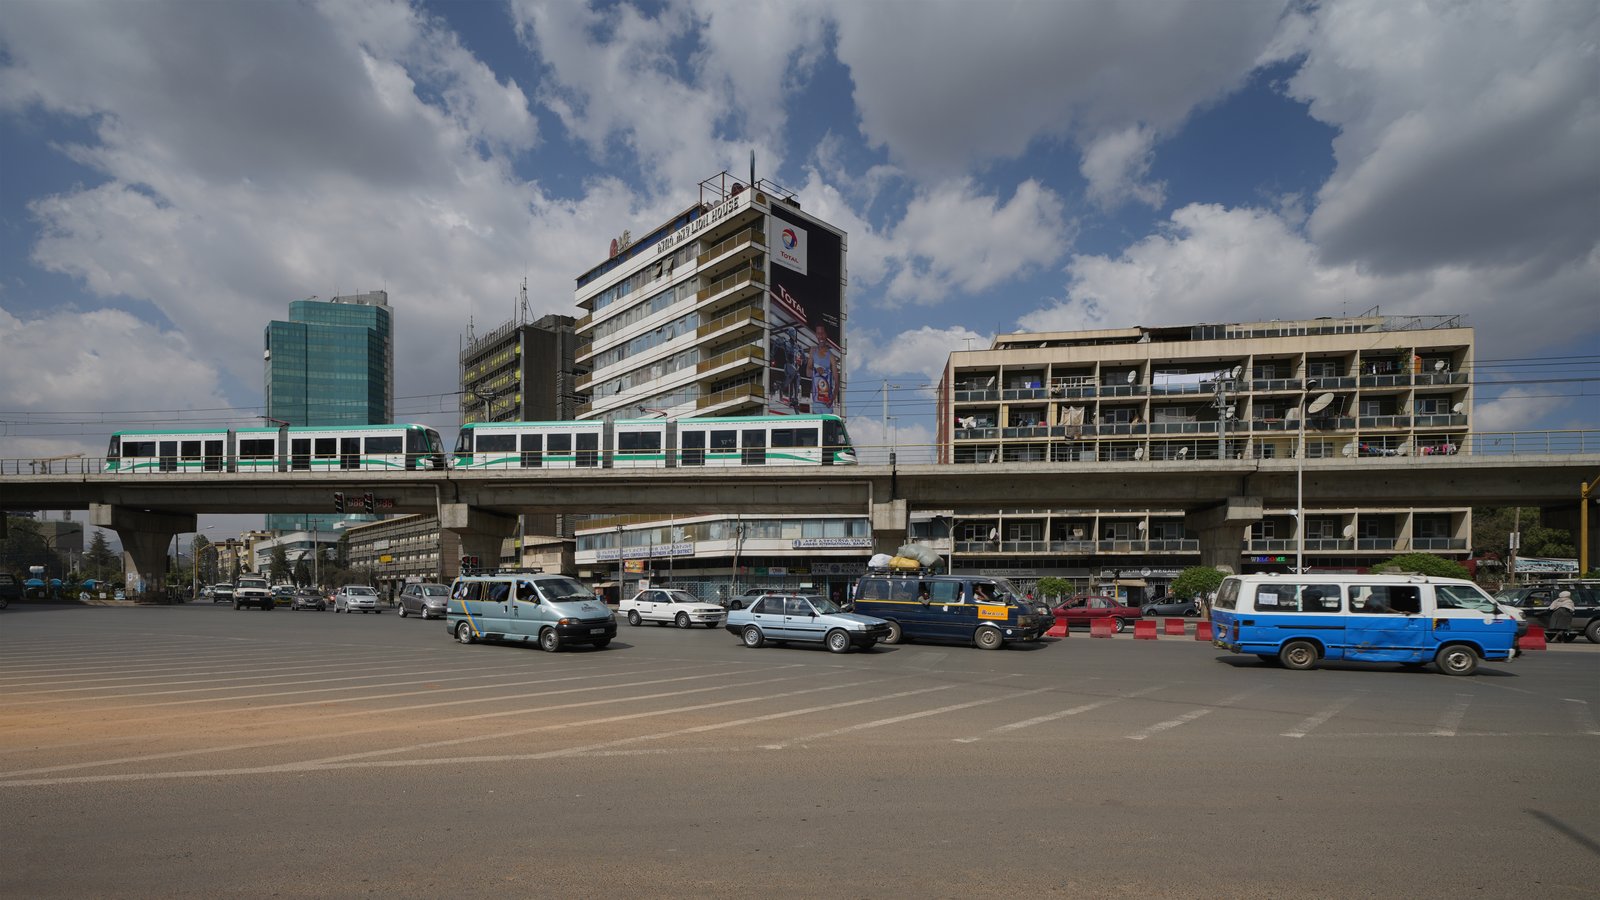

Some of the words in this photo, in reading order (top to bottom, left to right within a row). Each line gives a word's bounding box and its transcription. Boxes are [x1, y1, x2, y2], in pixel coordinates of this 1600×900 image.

[691, 214, 709, 235] LION
[711, 196, 740, 222] HOUSE
[780, 250, 799, 264] TOTAL
[778, 284, 807, 318] TOTAL
